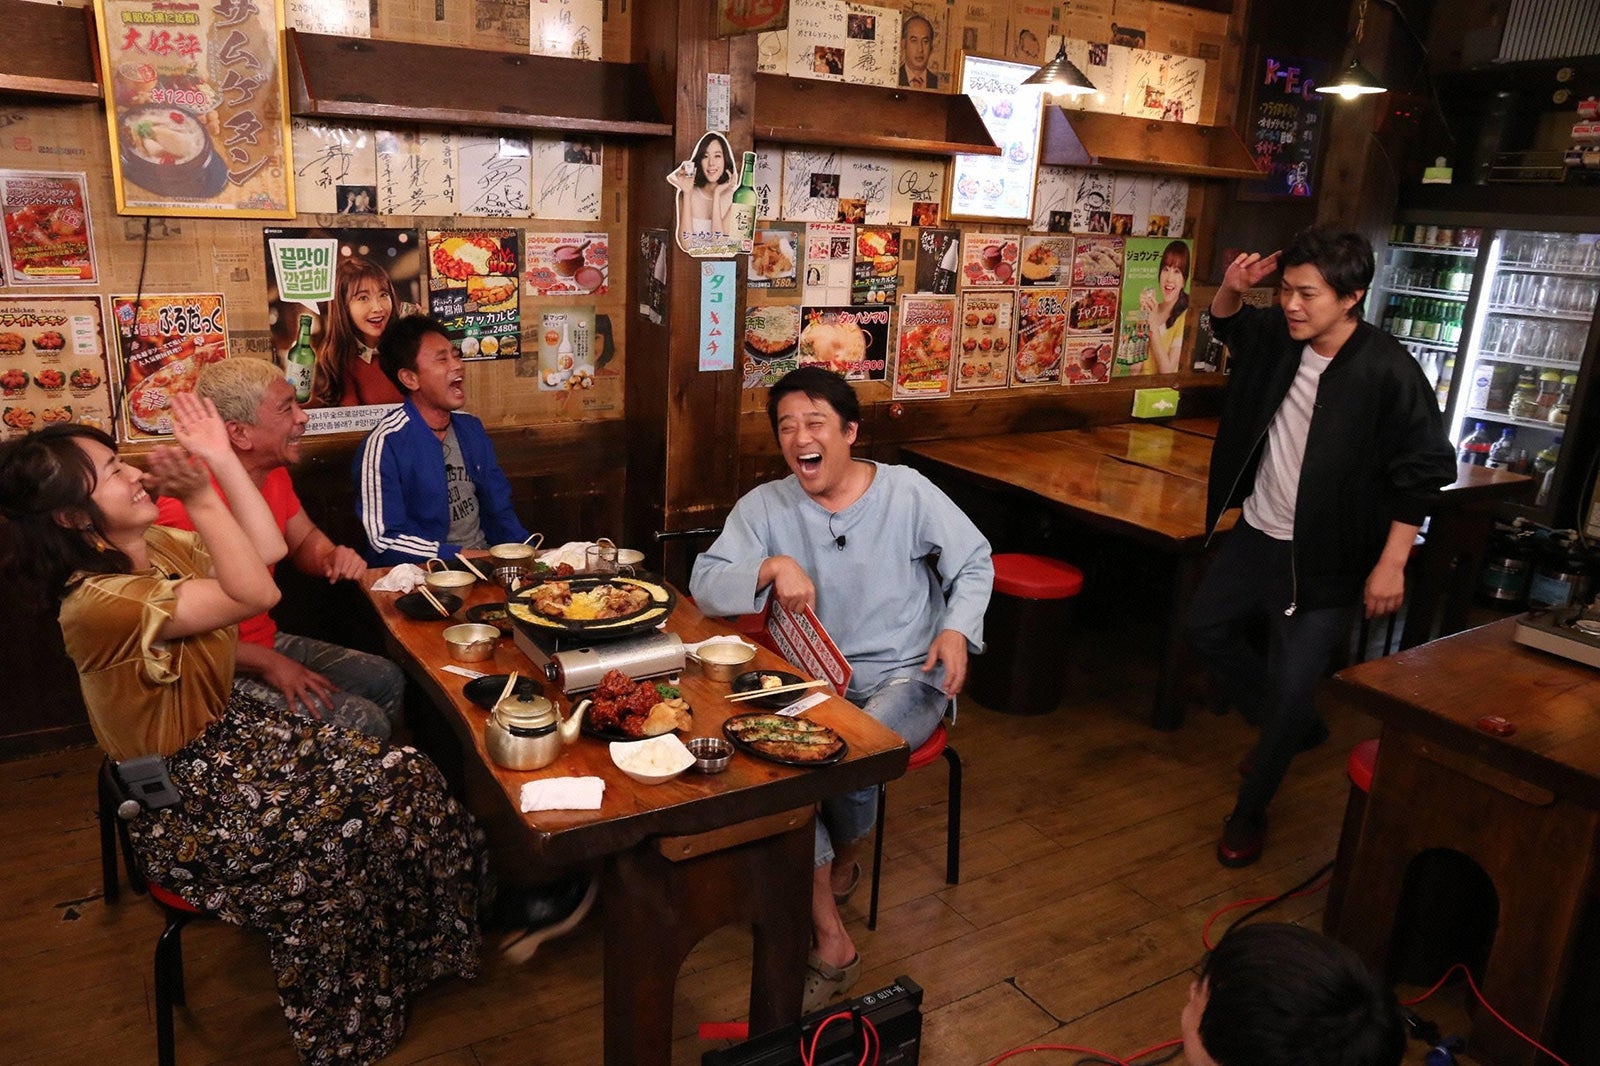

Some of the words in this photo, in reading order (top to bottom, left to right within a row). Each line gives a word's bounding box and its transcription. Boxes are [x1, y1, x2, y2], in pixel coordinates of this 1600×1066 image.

[121, 27, 203, 60] 大好評
[279, 247, 330, 270] 끝맛이
[283, 269, 329, 291] 깔끔해
